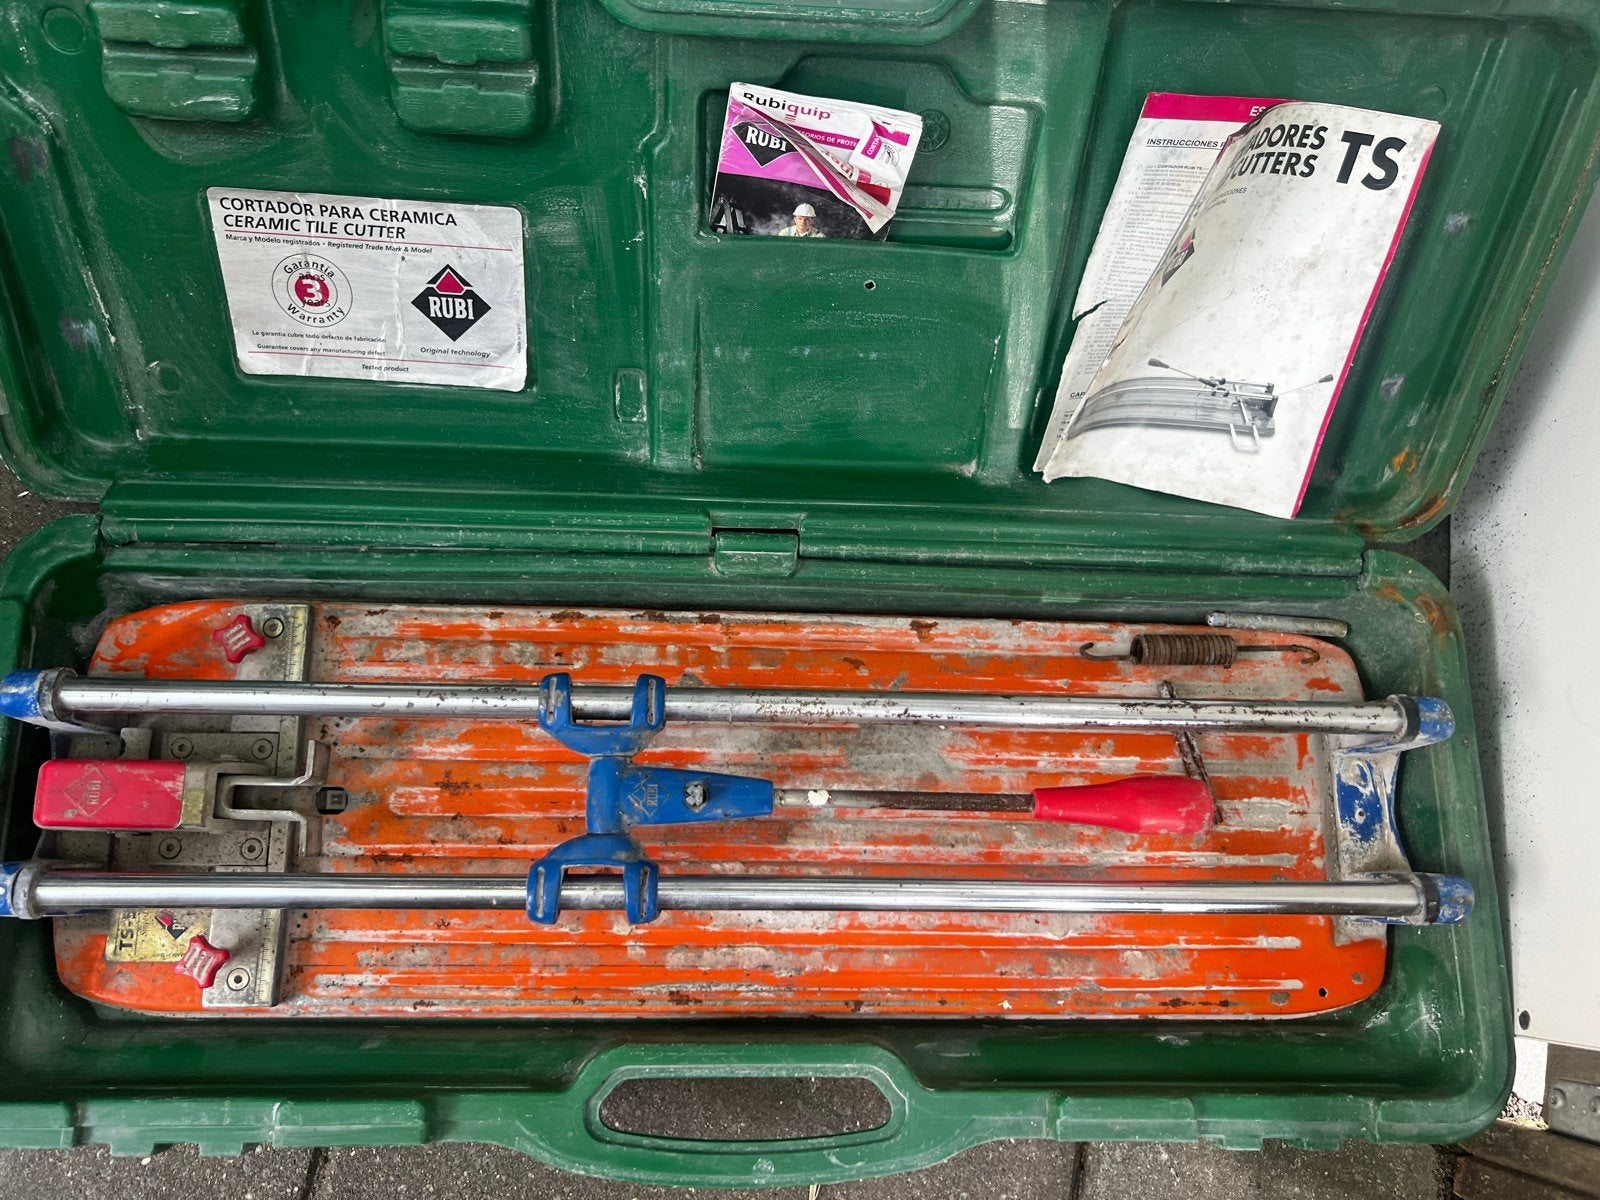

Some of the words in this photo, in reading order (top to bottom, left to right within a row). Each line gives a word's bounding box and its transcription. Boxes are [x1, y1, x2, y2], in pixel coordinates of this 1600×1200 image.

[745, 125, 787, 152] RUBI
[1146, 138, 1219, 148] INSTRUCCIONES
[1336, 130, 1407, 191] TS
[220, 196, 315, 217] CORTADOR
[319, 204, 365, 220] PARA
[369, 208, 458, 227] CERAMICA
[223, 214, 301, 232] CERAMIC
[306, 220, 339, 235] TILE
[344, 223, 406, 240] CUTTER
[225, 233, 248, 242] Marca
[254, 236, 281, 245] Modelo
[327, 241, 364, 250] Registered
[365, 243, 384, 251] Trade
[385, 245, 402, 253] Mark
[301, 279, 323, 303] 3
[287, 303, 345, 324] Warranty
[428, 296, 475, 321] RUBI
[322, 348, 366, 356] manufacturing
[420, 347, 449, 356] Original
[450, 349, 491, 359] technology
[362, 363, 383, 371] Tested
